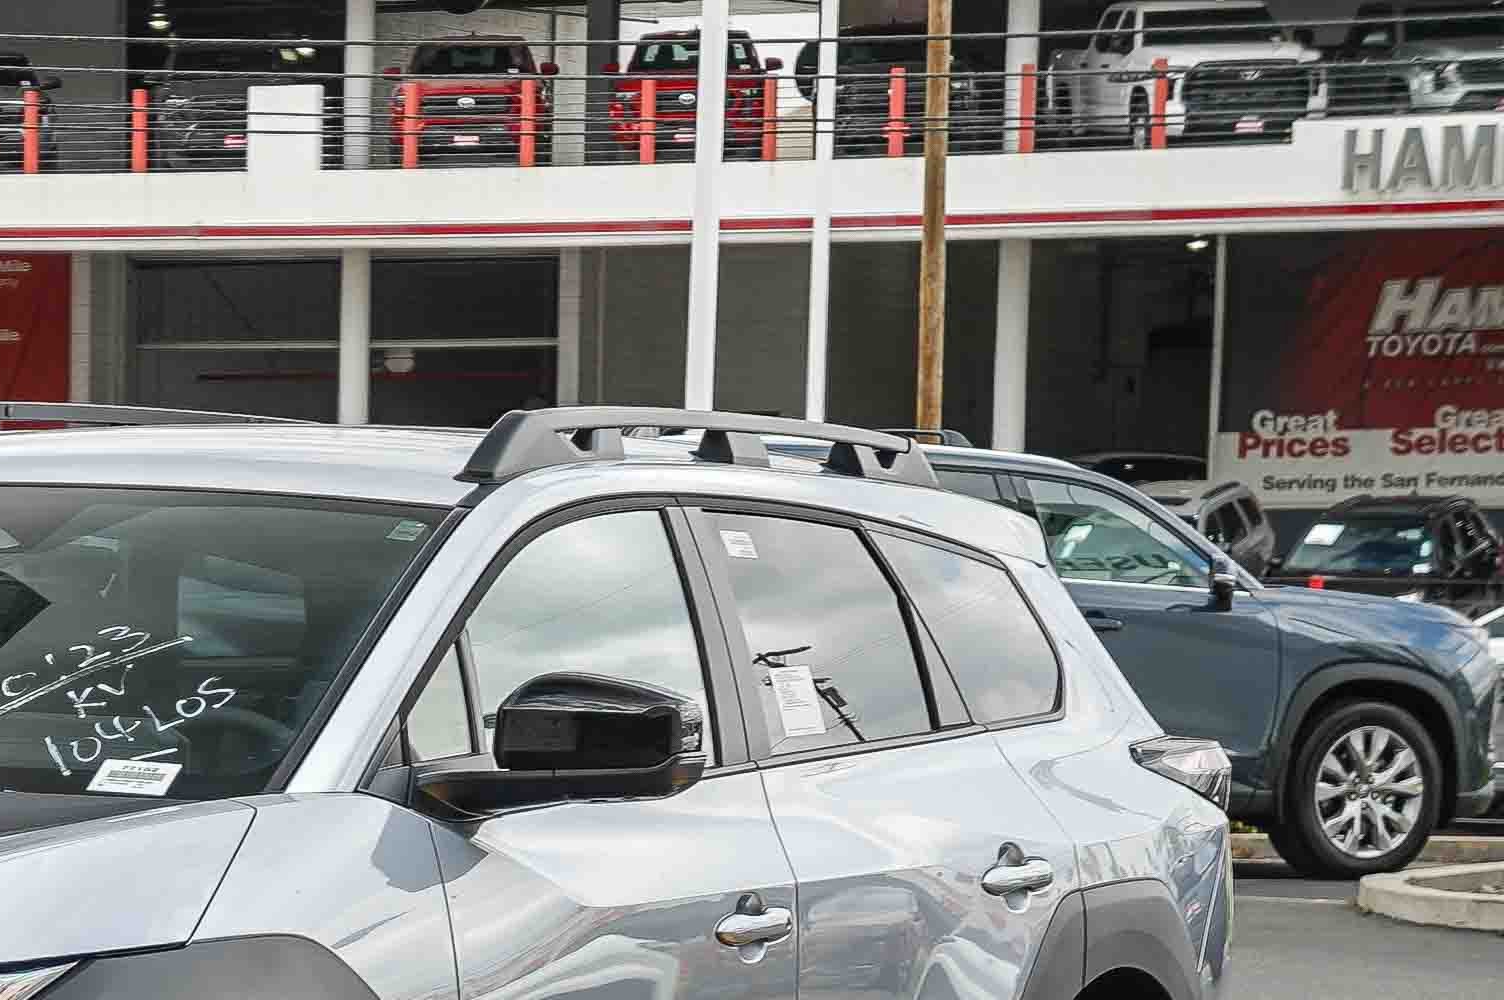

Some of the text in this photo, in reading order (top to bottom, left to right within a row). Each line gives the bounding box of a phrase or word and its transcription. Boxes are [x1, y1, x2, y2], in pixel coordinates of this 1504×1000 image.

[1365, 331, 1476, 358] TOYOTA
[1251, 408, 1338, 435] Great
[1237, 431, 1351, 459] Prices
[1262, 474, 1338, 493] Serving
[1343, 472, 1376, 489] the
[1381, 472, 1419, 489] San
